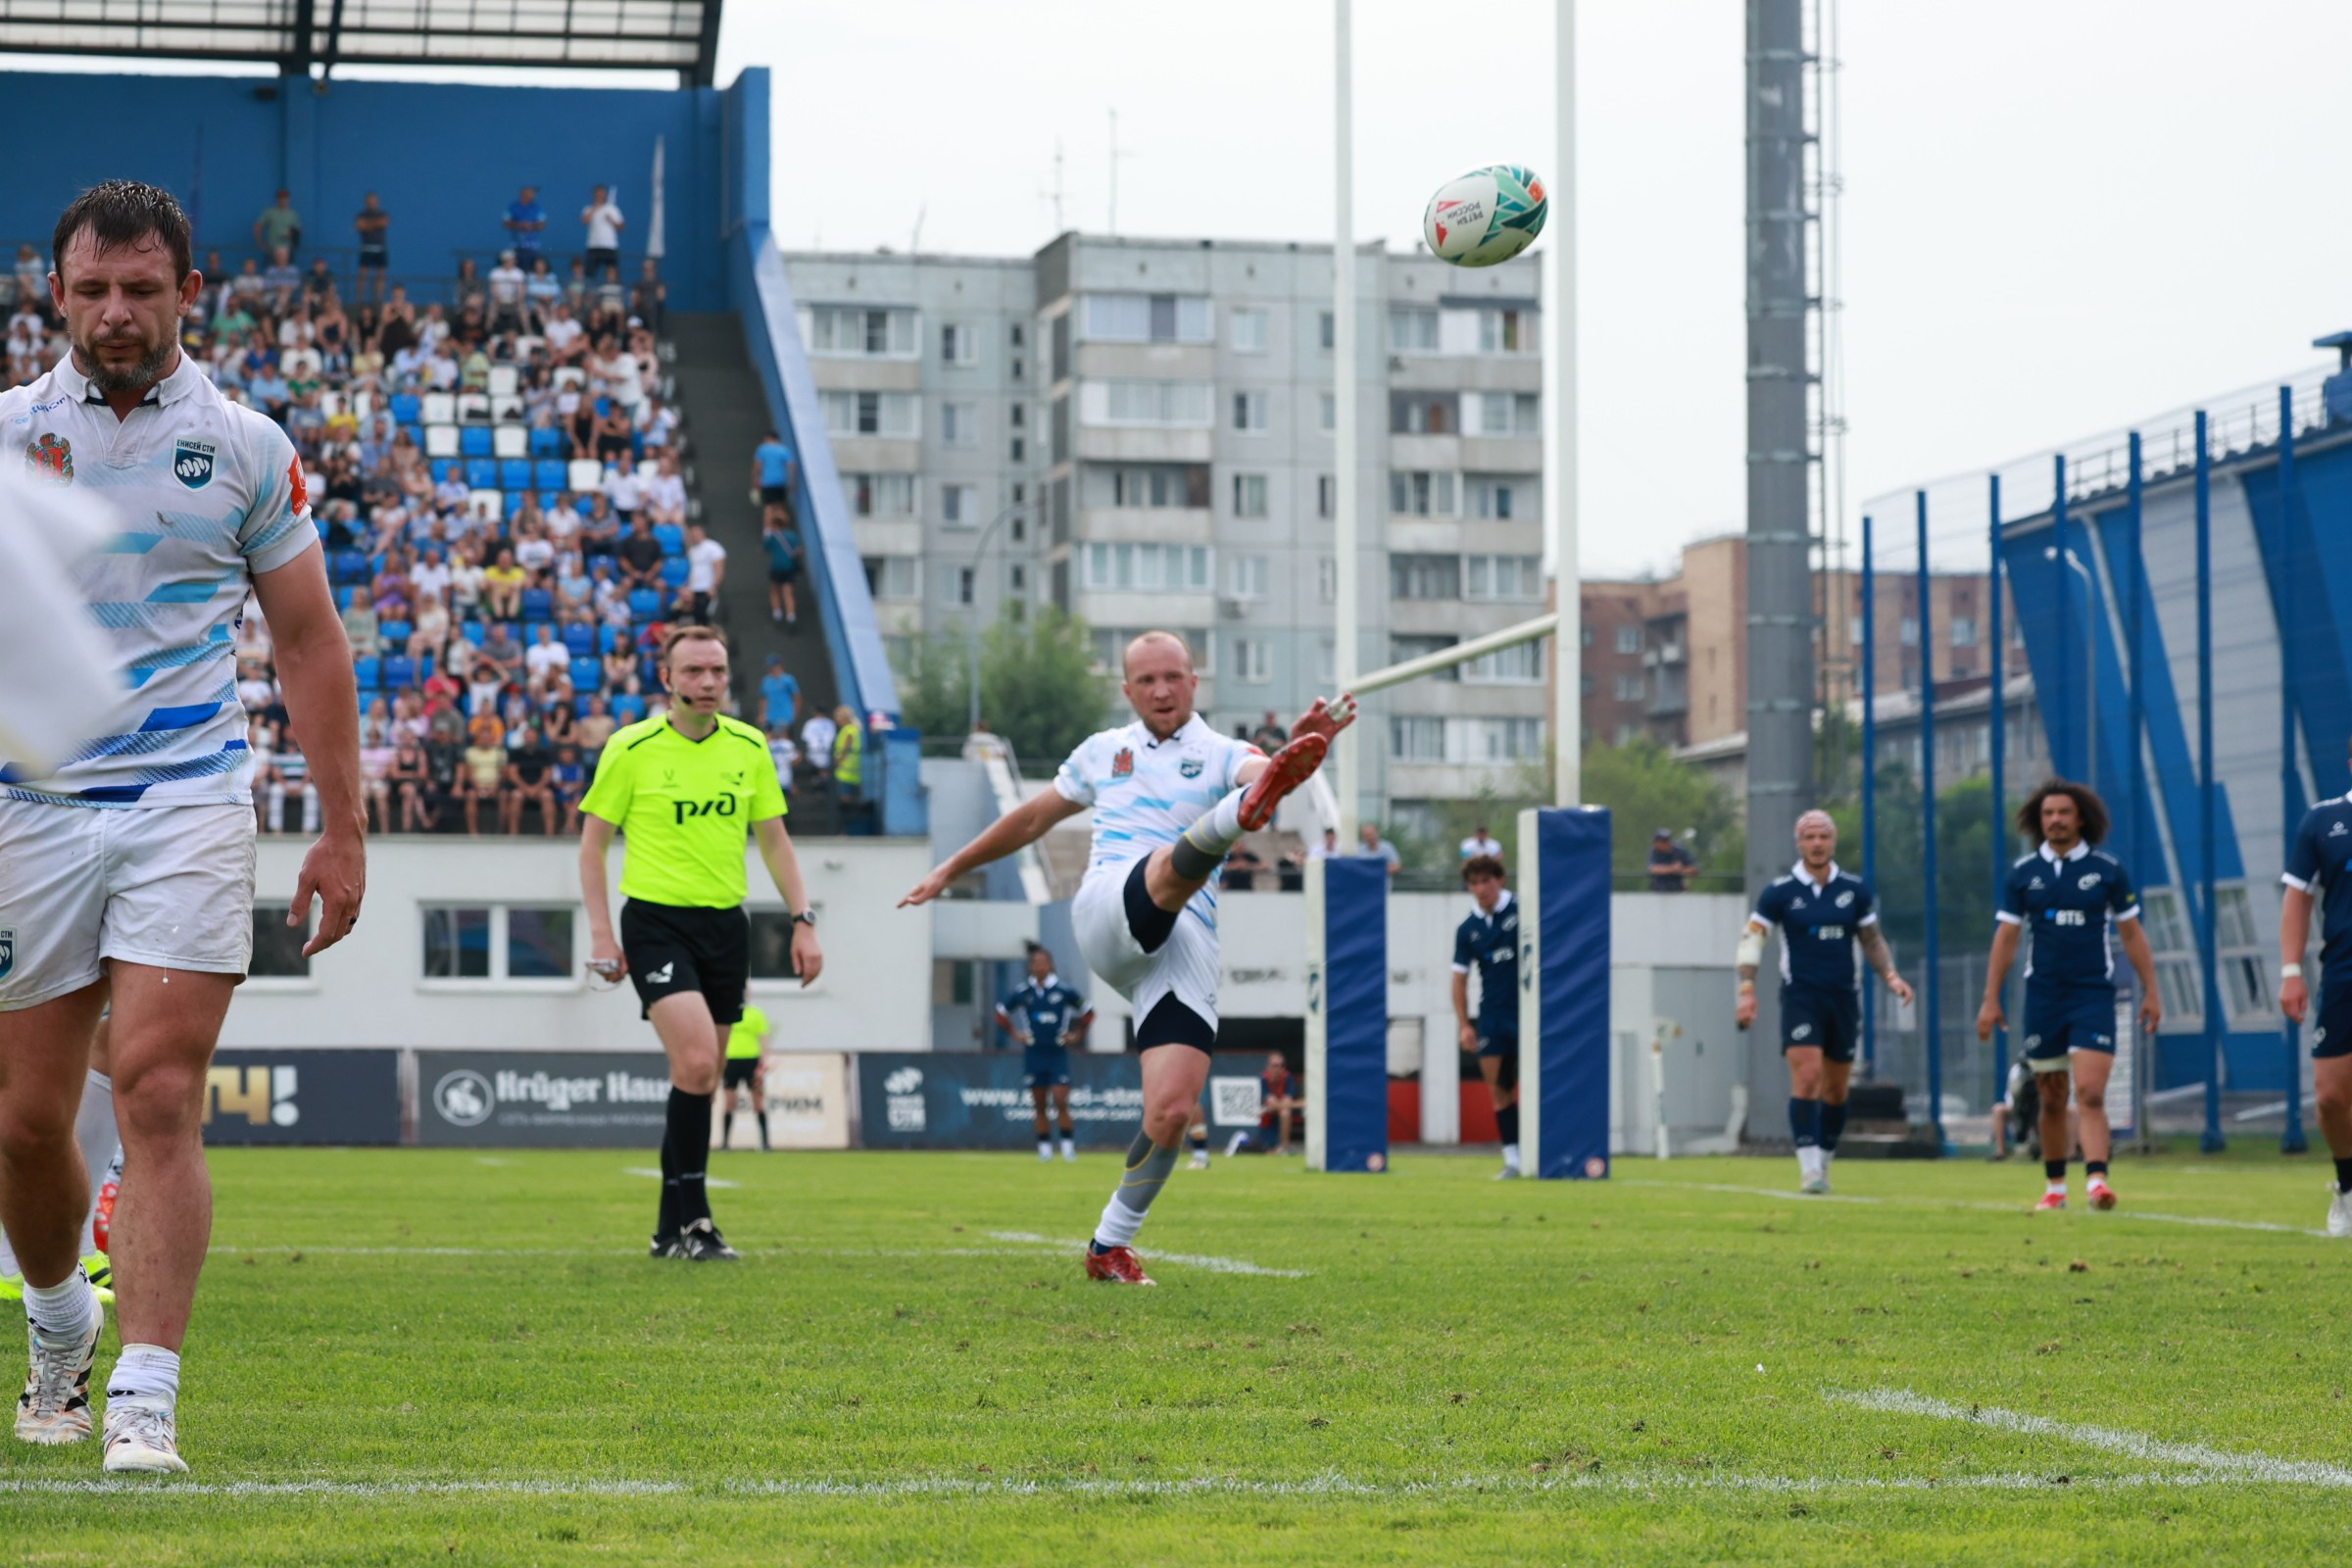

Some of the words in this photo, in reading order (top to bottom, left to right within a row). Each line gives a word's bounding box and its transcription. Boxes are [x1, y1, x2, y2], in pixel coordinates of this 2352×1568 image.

[176, 439, 202, 451] ЕНИСЕЙ
[202, 444, 216, 454] СТМ
[495, 1070, 603, 1111] Krüger
